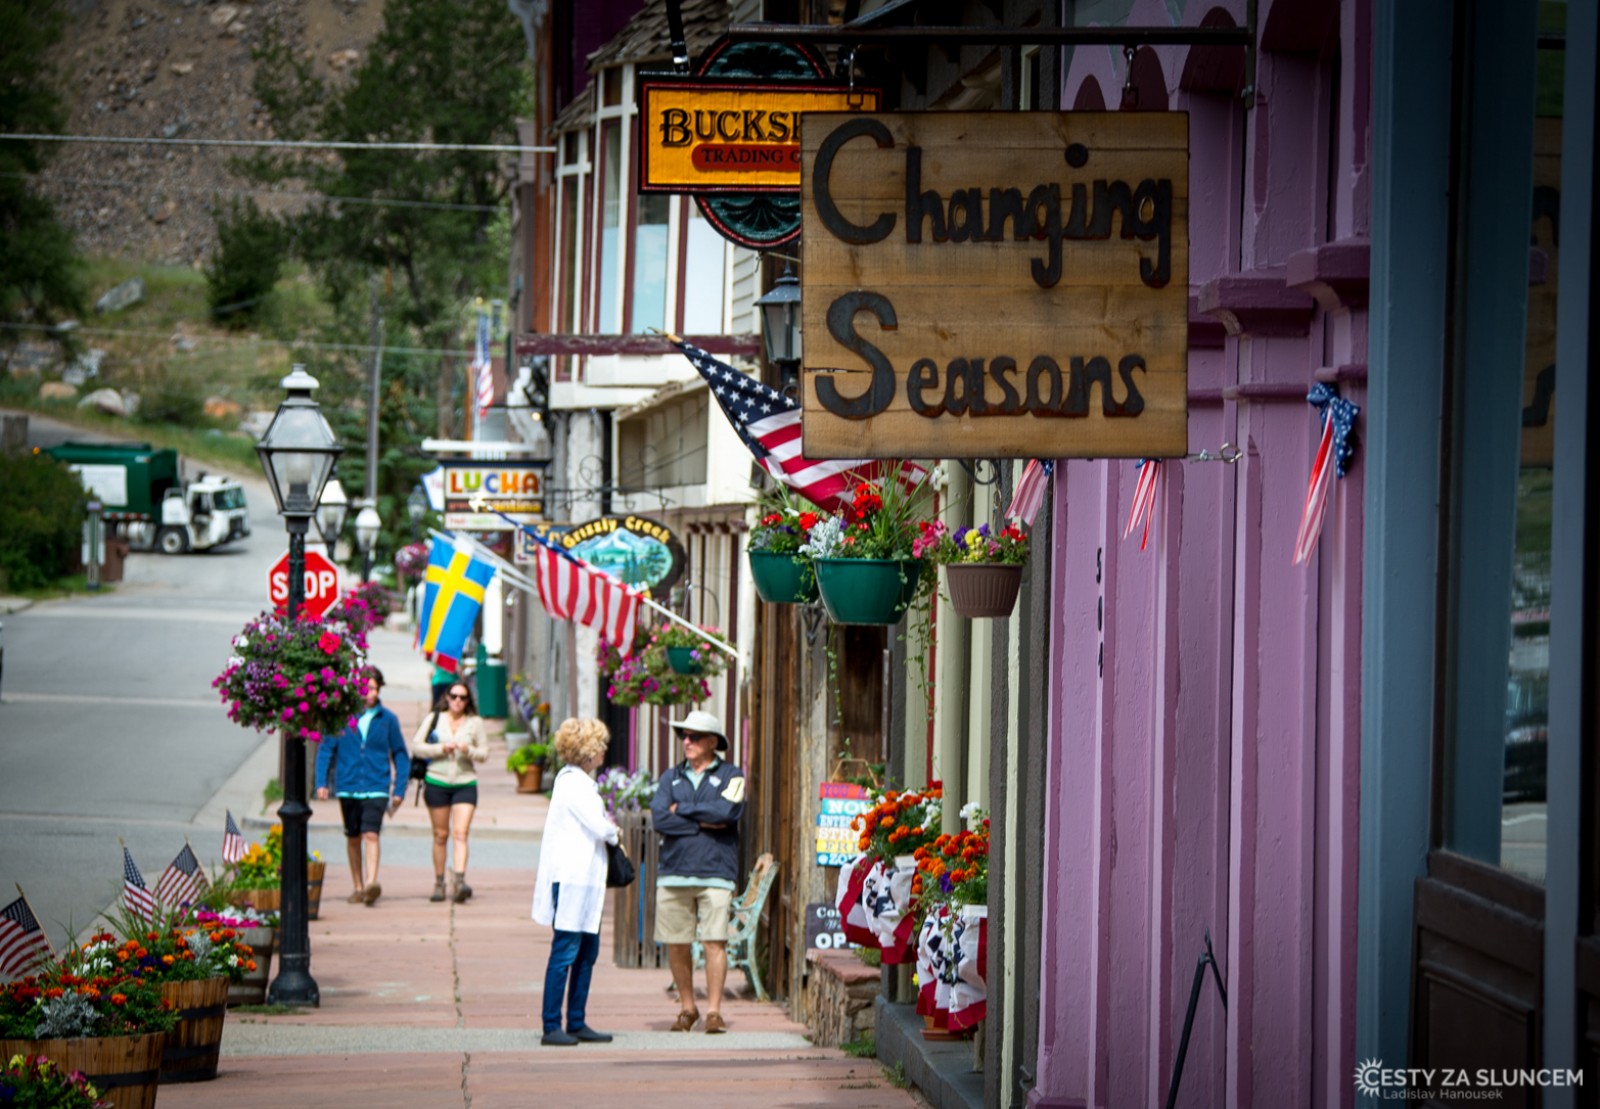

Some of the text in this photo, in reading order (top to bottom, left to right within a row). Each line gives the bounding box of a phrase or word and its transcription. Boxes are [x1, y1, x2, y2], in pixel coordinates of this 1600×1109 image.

[701, 149, 784, 163] TRADING
[812, 117, 1172, 289] Changing
[814, 290, 1147, 421] Seasons
[450, 471, 539, 494] LUCHA
[562, 516, 618, 549] Grizzly
[625, 515, 671, 545] Creek
[272, 570, 335, 600] SOP
[829, 853, 855, 865] ZO
[816, 906, 841, 919] Co
